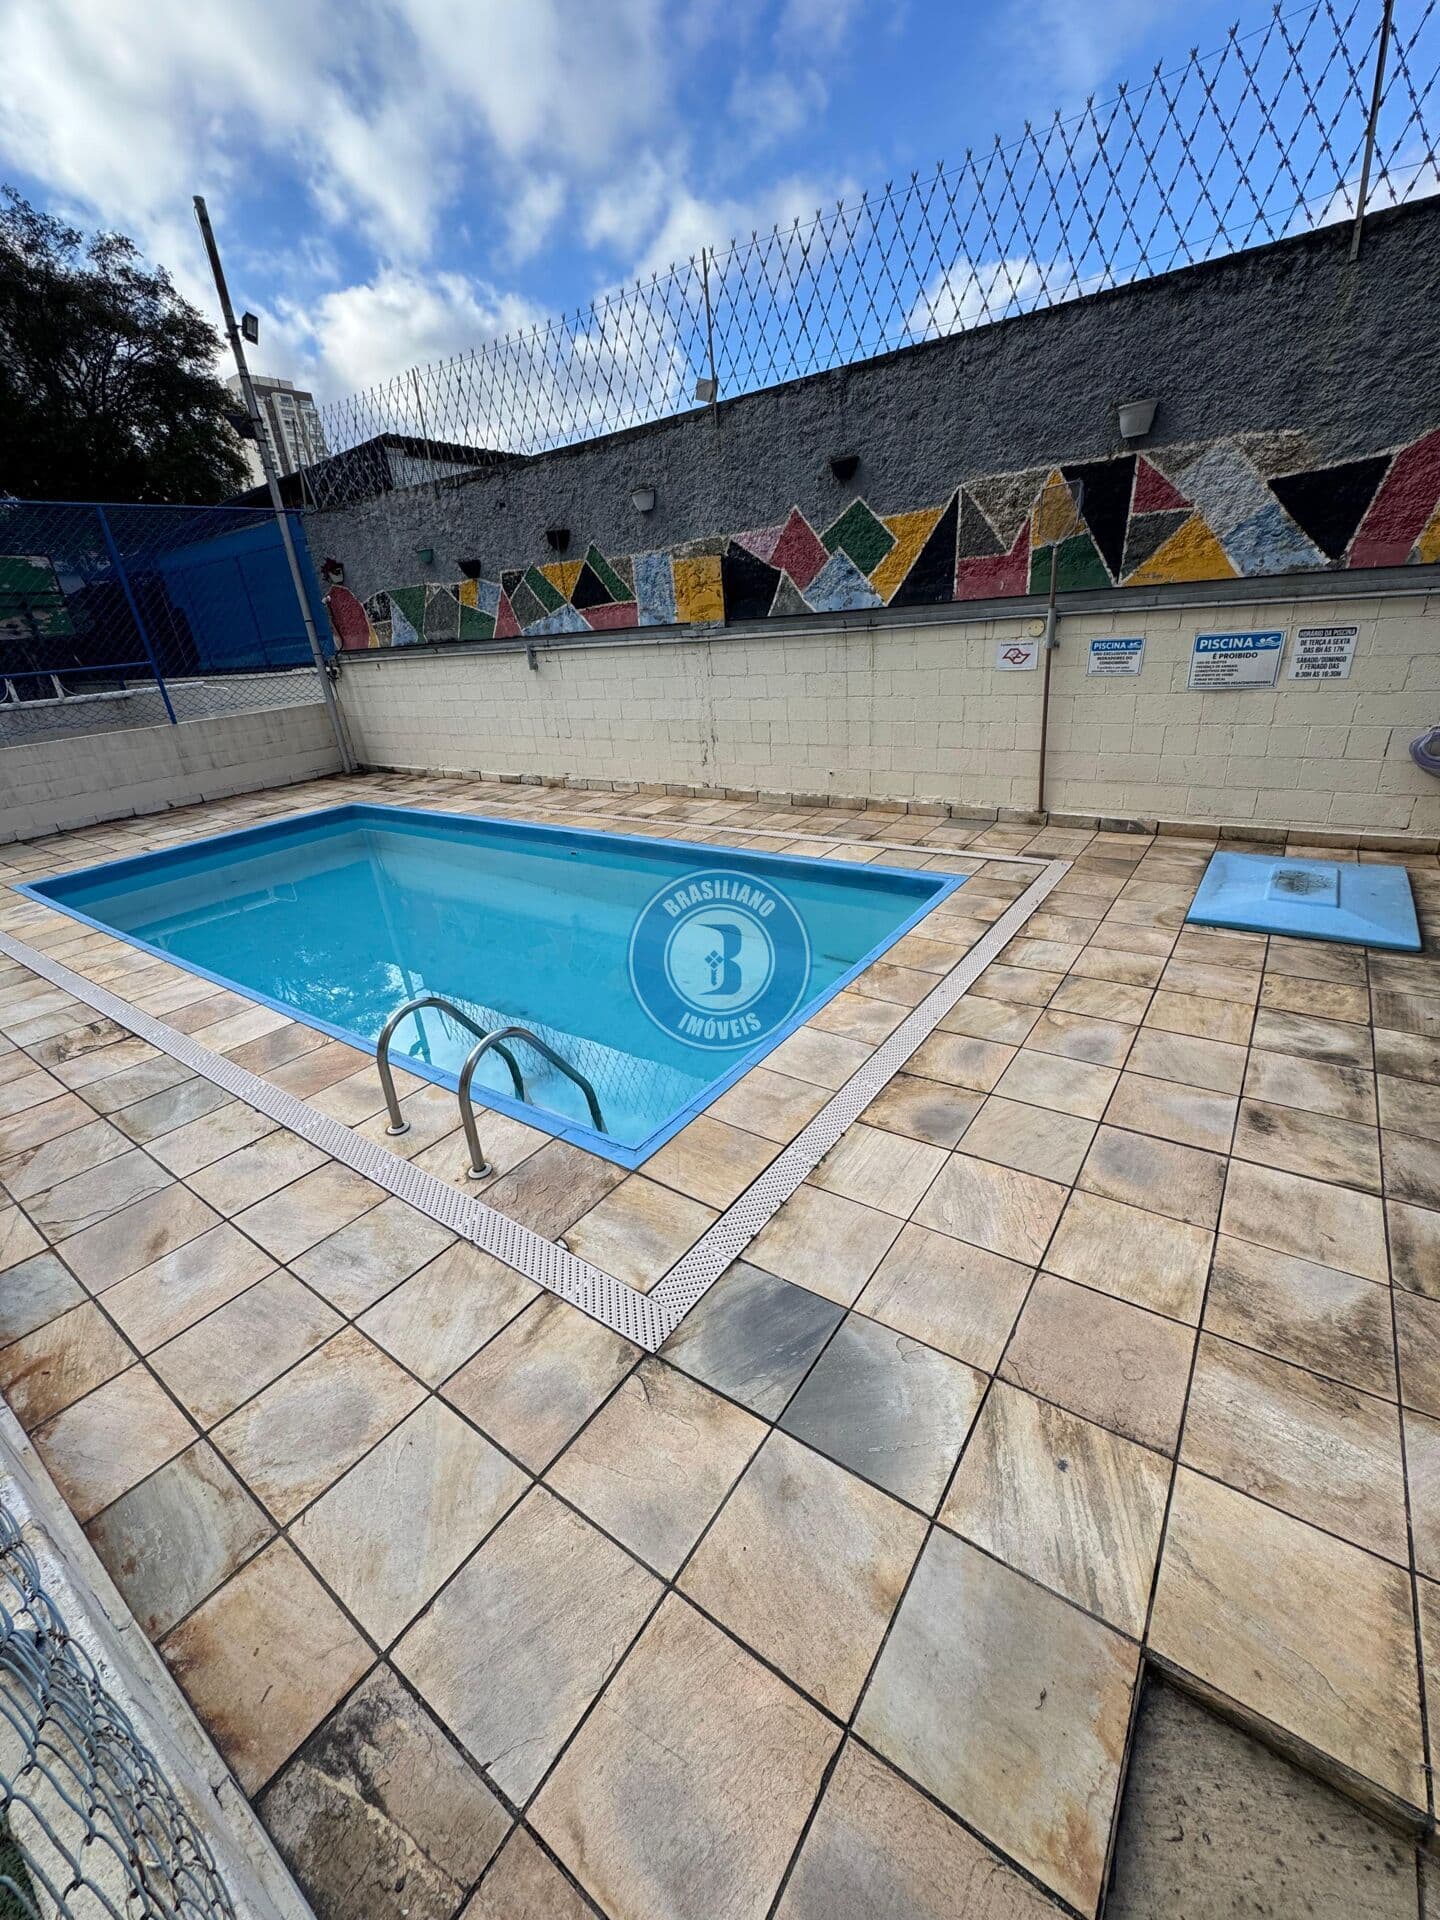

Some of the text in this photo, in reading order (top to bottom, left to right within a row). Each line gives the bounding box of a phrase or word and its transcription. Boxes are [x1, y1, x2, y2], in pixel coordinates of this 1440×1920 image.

[1093, 641, 1127, 650] PISCINA
[1199, 637, 1254, 650] PISCINA
[1309, 638, 1326, 646] TERÇA
[1302, 646, 1315, 654] DAS
[1333, 645, 1345, 653] 17H
[1218, 651, 1258, 660] PROIBIDO
[1304, 662, 1328, 670] FERIADO
[1328, 662, 1340, 670] DAS
